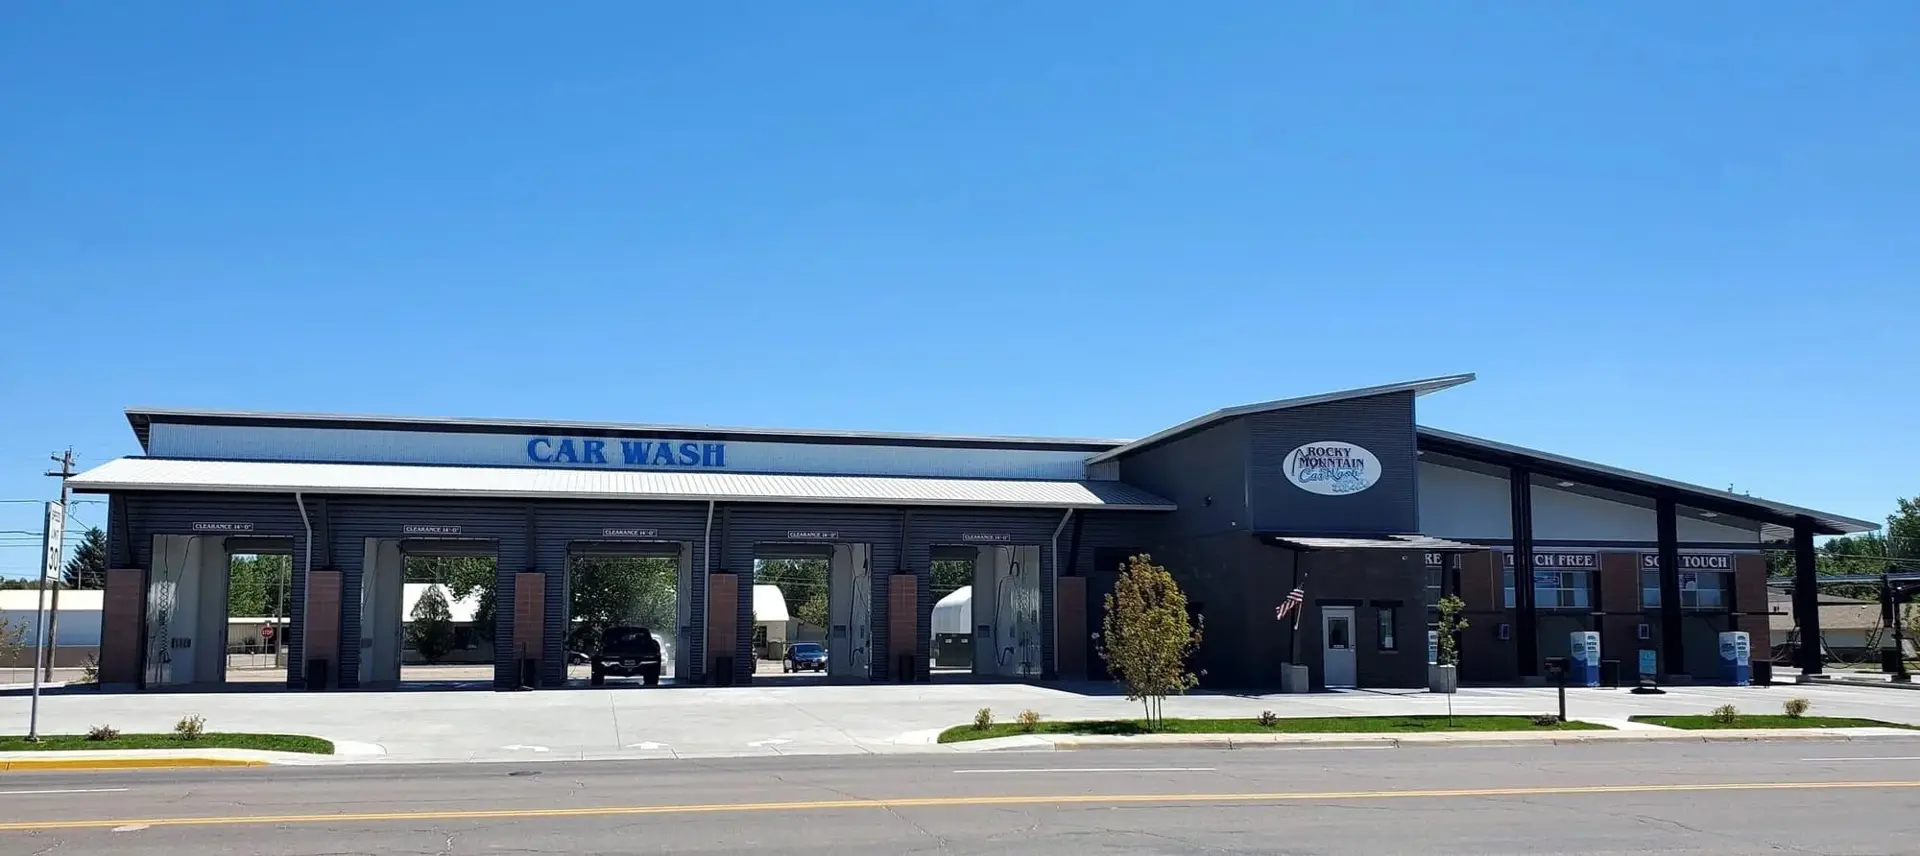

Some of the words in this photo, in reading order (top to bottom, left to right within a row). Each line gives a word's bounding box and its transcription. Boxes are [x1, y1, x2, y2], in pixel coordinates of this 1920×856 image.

[527, 438, 608, 464] CAR
[620, 440, 727, 467] WASH
[1307, 446, 1352, 457] ROCKY
[1299, 457, 1364, 468] MOUNTAIN
[49, 546, 58, 571] 30
[1506, 554, 1553, 566] TCH
[1558, 554, 1593, 566] FREE
[1682, 556, 1728, 568] TOUCH
